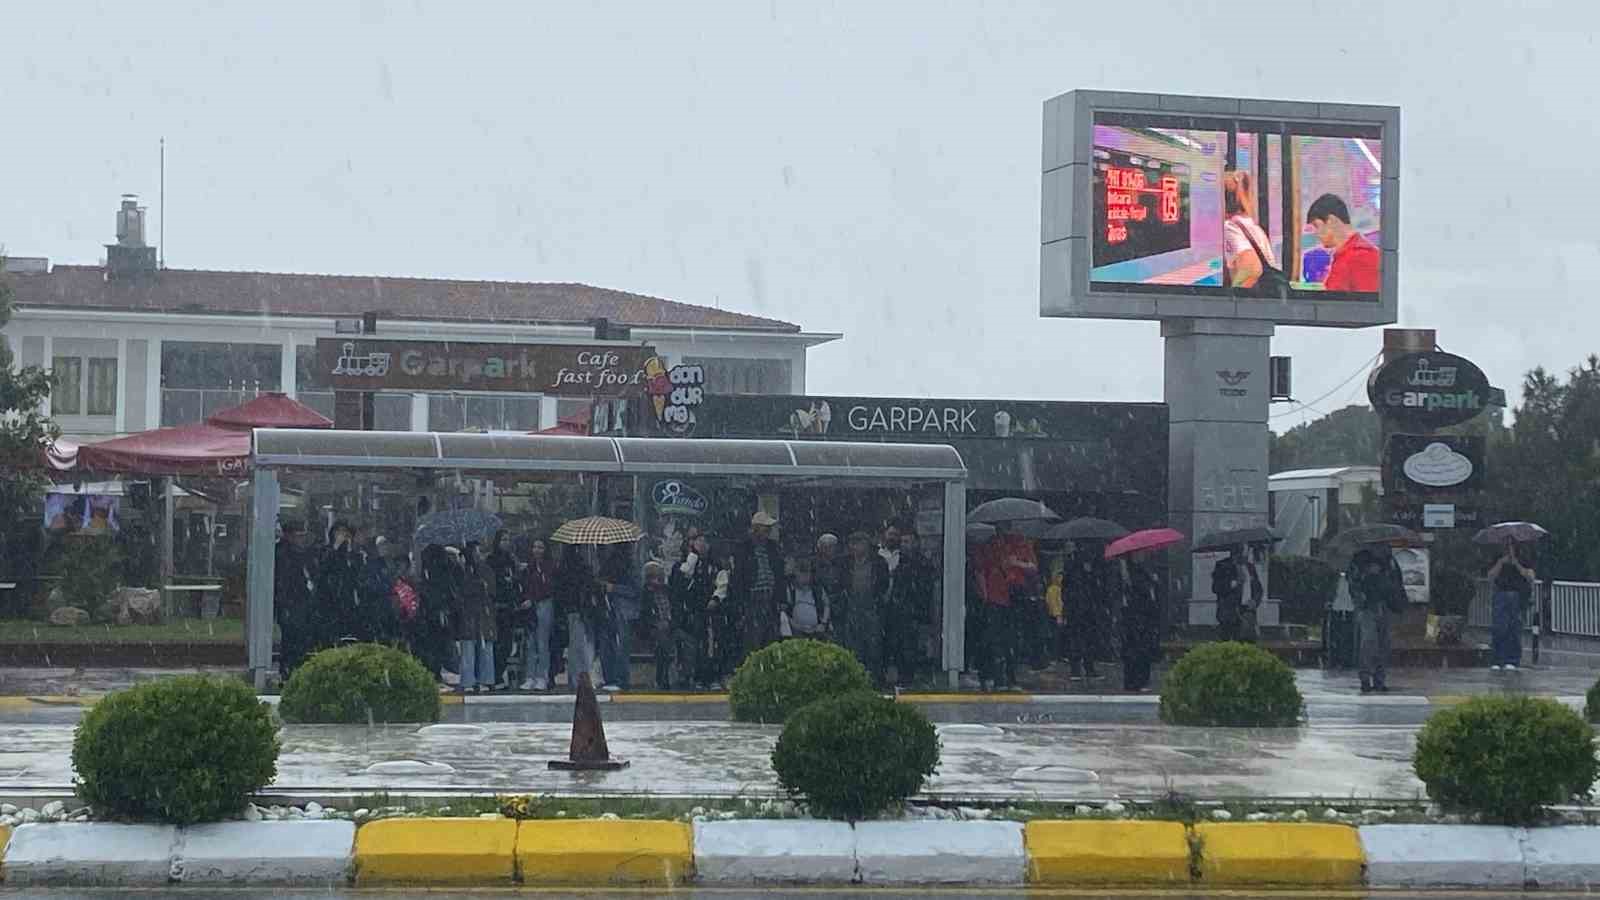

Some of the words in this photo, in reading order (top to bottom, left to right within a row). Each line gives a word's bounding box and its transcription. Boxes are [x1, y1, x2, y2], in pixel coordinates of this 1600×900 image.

[577, 351, 619, 368] Cafe
[551, 367, 592, 388] fast
[1384, 389, 1480, 412] Garpark
[848, 405, 977, 433] GARPARK
